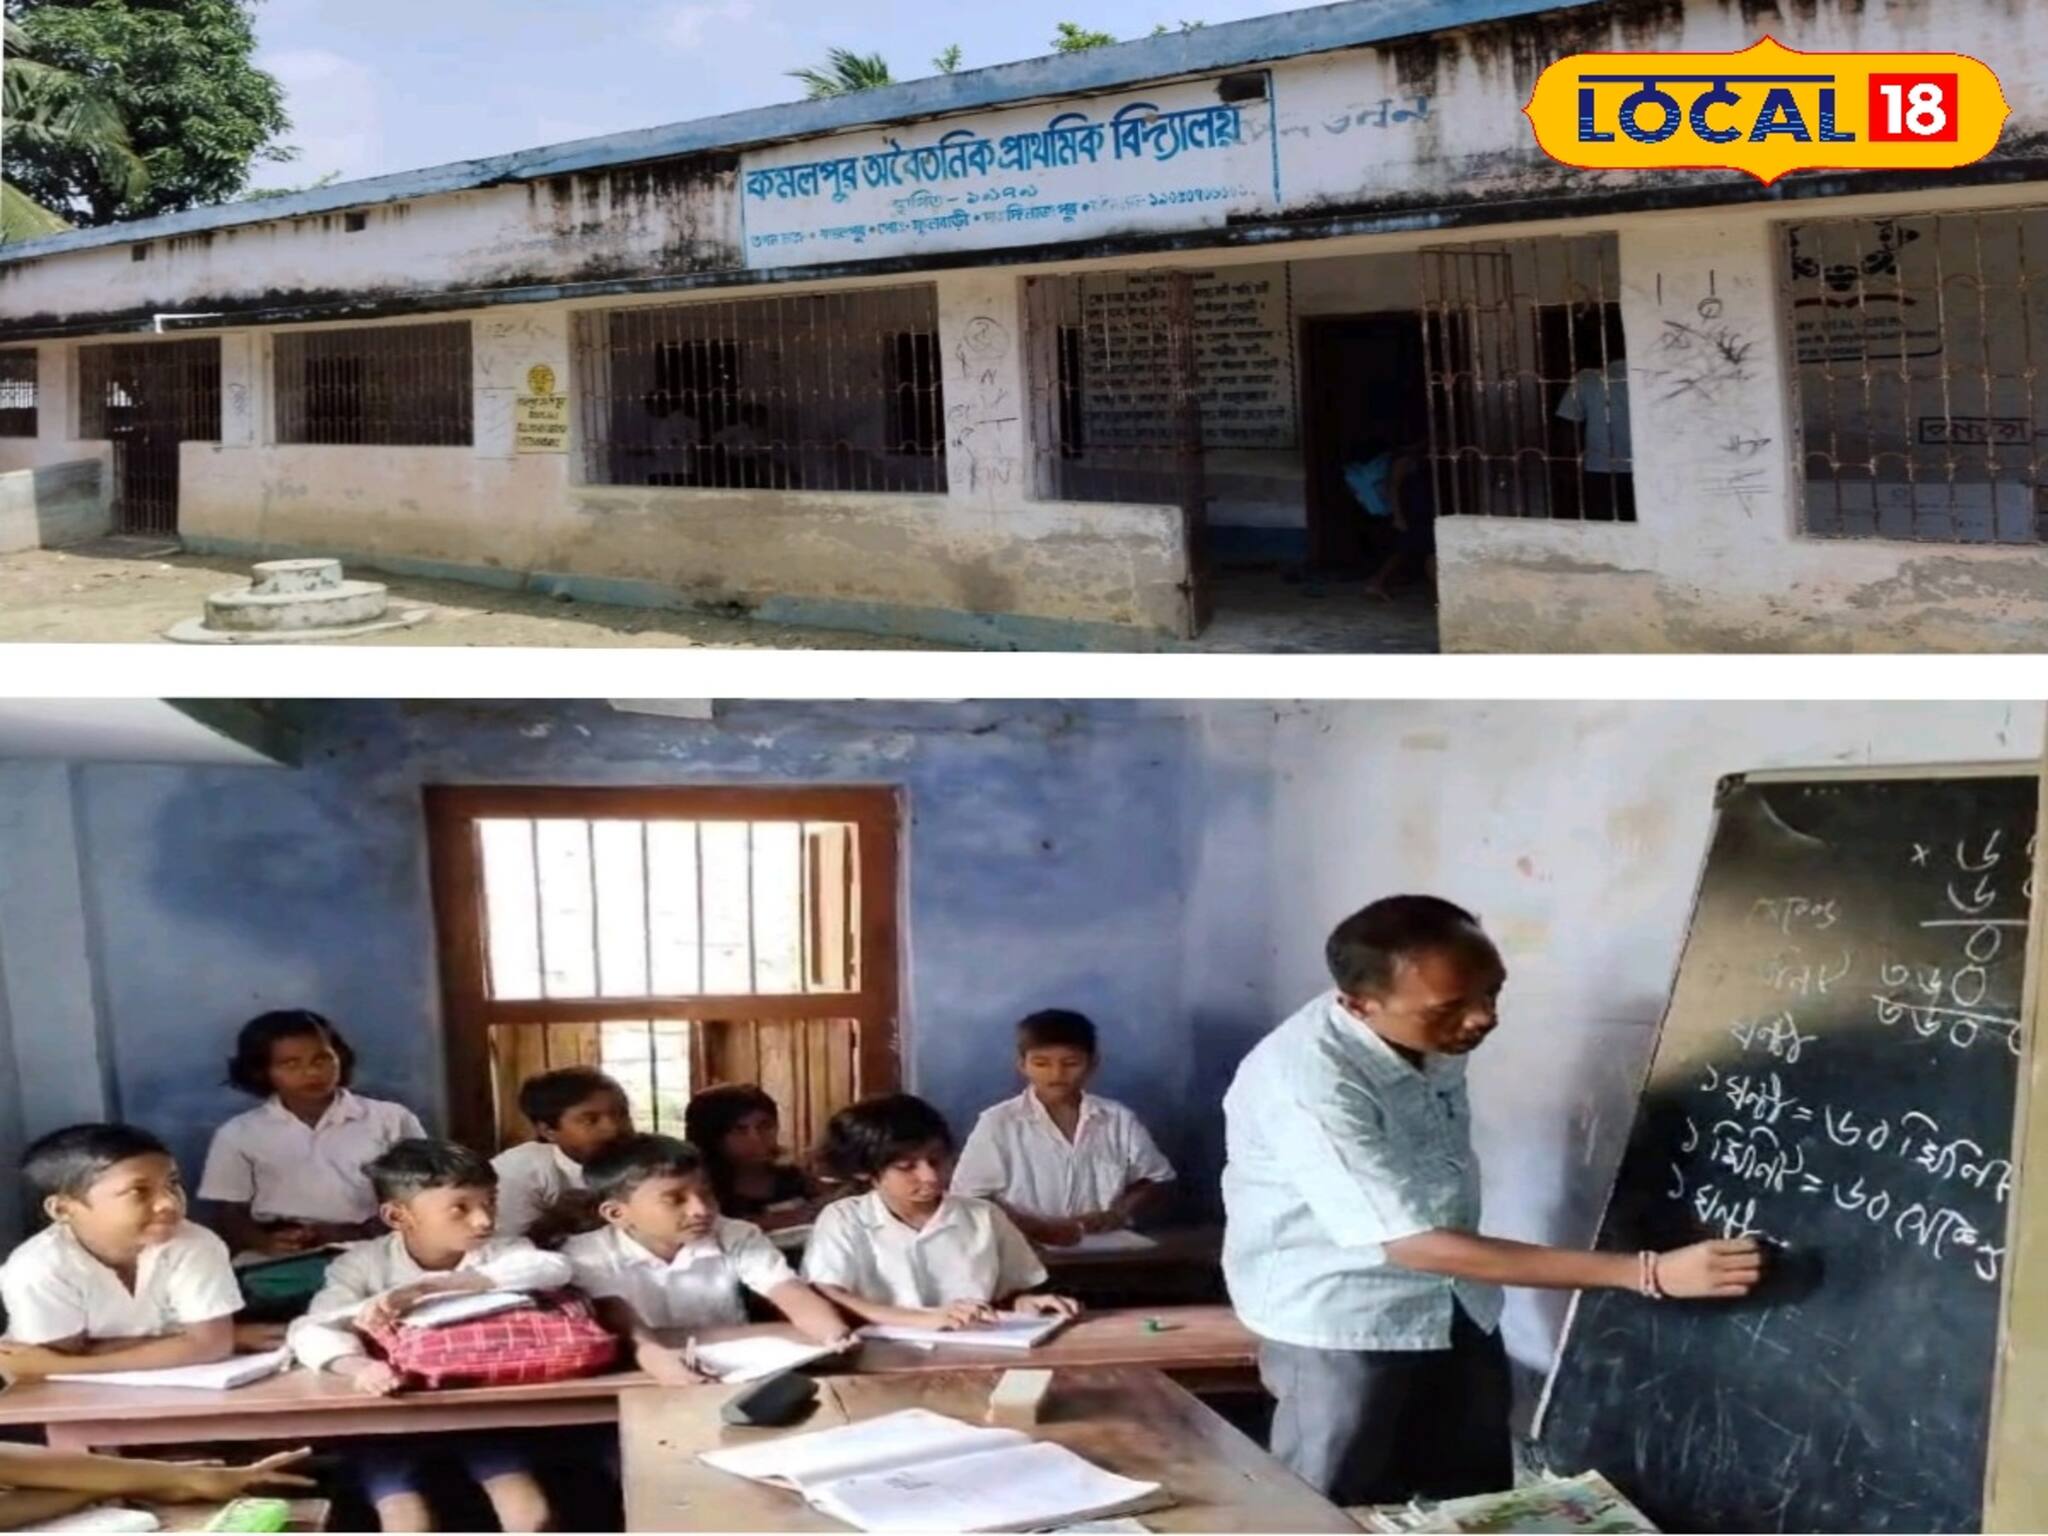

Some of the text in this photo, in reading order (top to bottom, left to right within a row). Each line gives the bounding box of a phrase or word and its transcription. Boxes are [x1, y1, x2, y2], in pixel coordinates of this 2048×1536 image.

[747, 155, 859, 203] কমলপুর
[863, 129, 996, 188] অবৈতনিক
[998, 112, 1105, 171] প্রাথমিক
[1109, 101, 1243, 162] বিদ্যালয়
